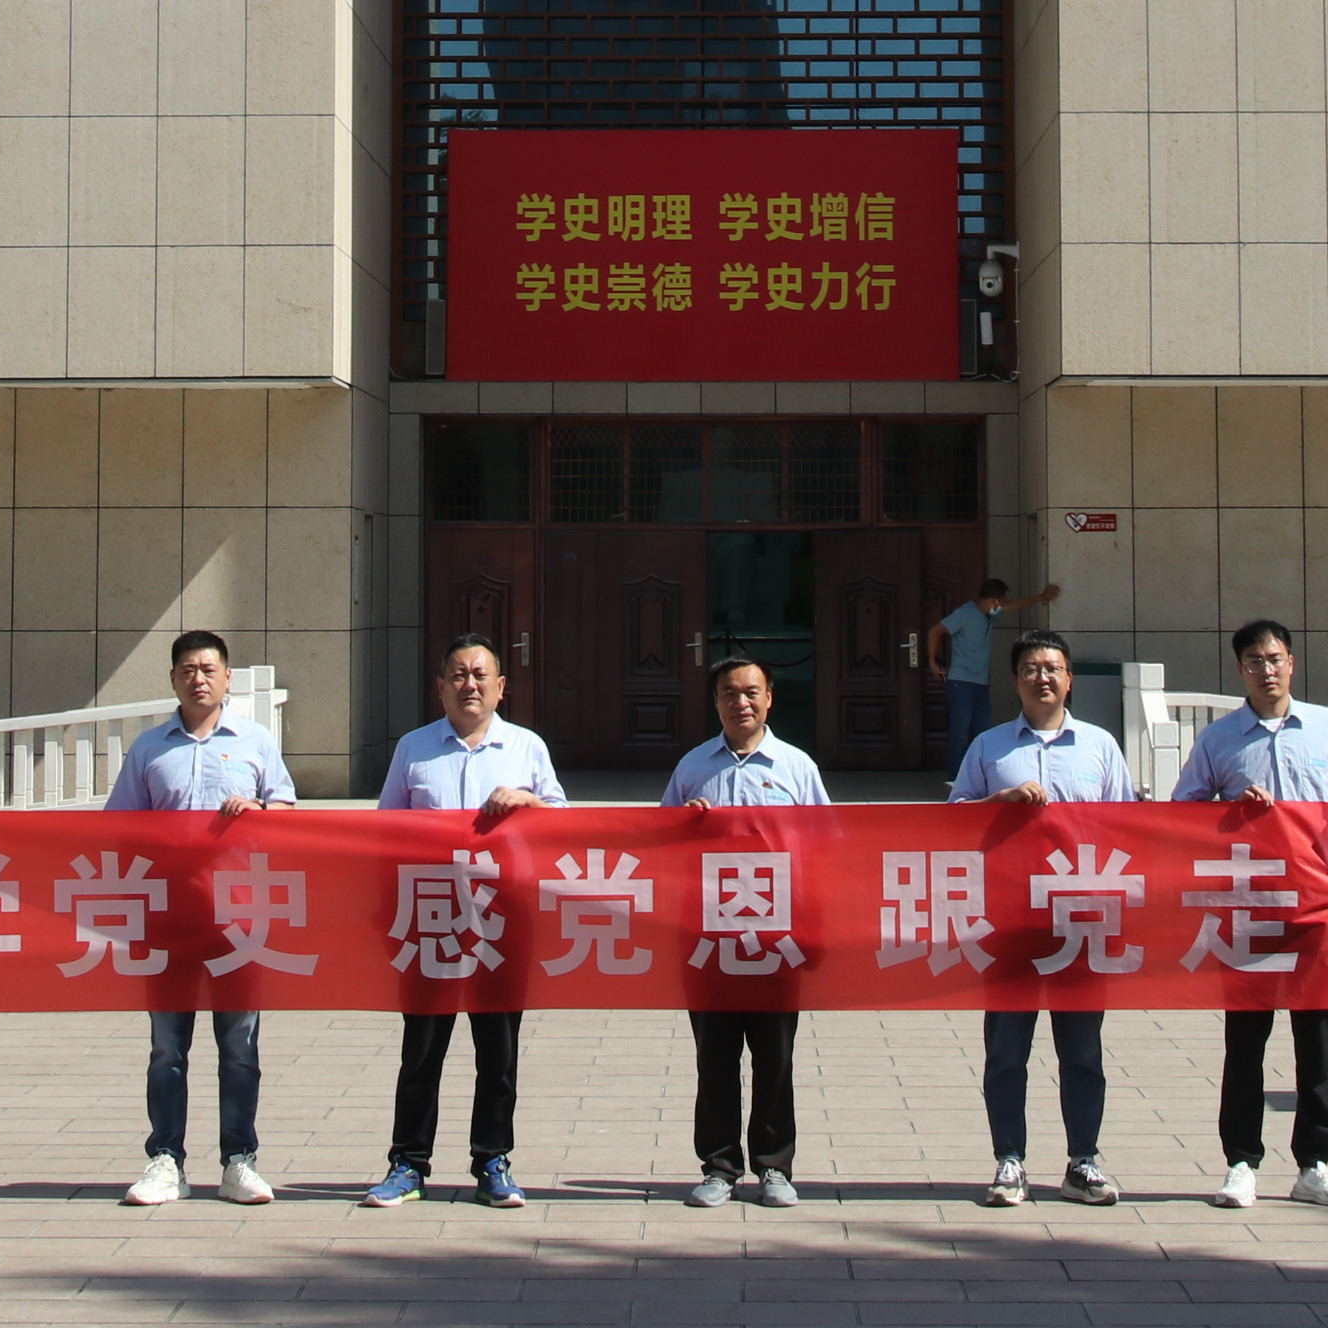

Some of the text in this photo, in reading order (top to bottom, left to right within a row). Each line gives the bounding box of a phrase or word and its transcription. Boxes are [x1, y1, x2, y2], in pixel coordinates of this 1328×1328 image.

[515, 192, 897, 243] 学史明理 学史增信
[515, 262, 897, 313] 学史崇德 学史力行
[388, 848, 804, 980] 感党恩
[875, 843, 1300, 977] 跟党走
